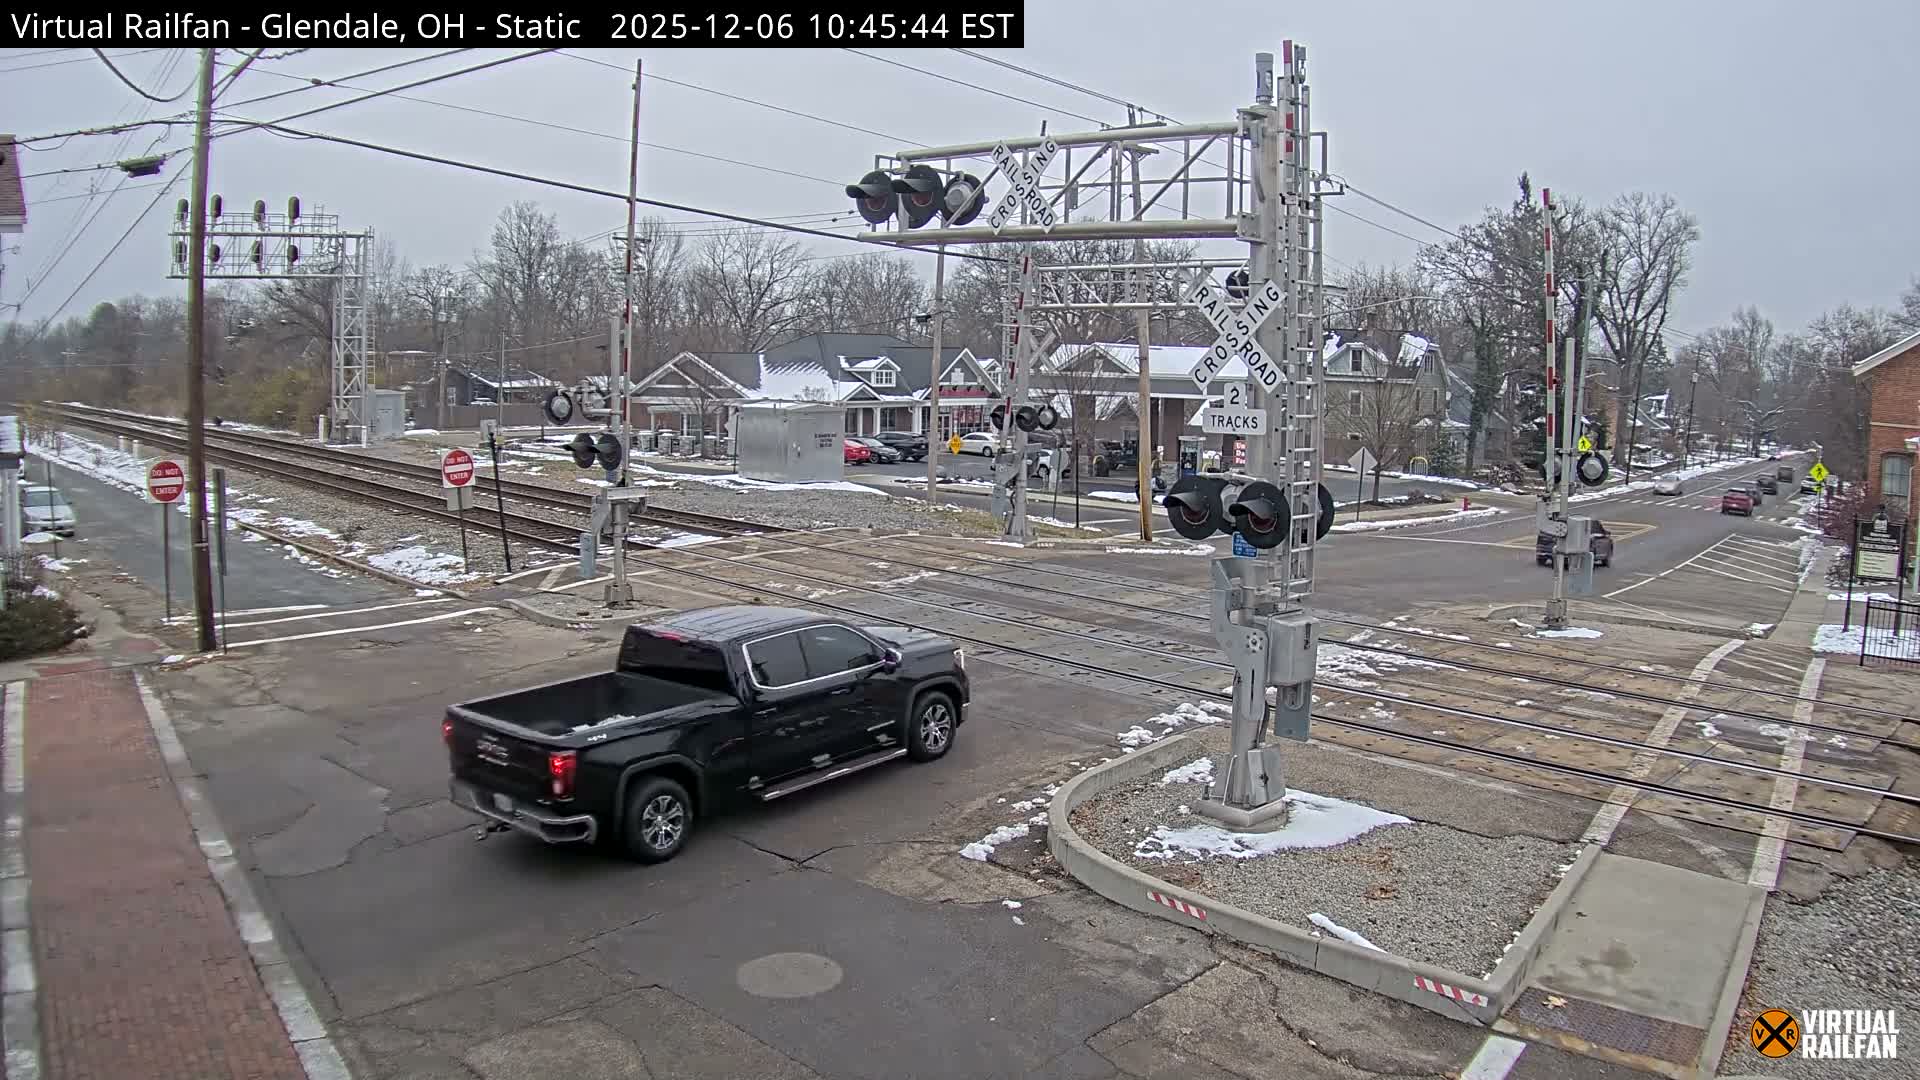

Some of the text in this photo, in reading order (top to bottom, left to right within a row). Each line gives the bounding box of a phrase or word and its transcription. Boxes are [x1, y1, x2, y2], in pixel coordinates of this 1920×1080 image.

[991, 140, 1055, 229] CROSSING
[1194, 286, 1280, 383] CROSSING
[1229, 387, 1240, 405] 2
[1210, 414, 1258, 429] TRACKS
[151, 469, 162, 477] DO
[450, 472, 469, 480] ENTER
[155, 486, 178, 495] ENTER
